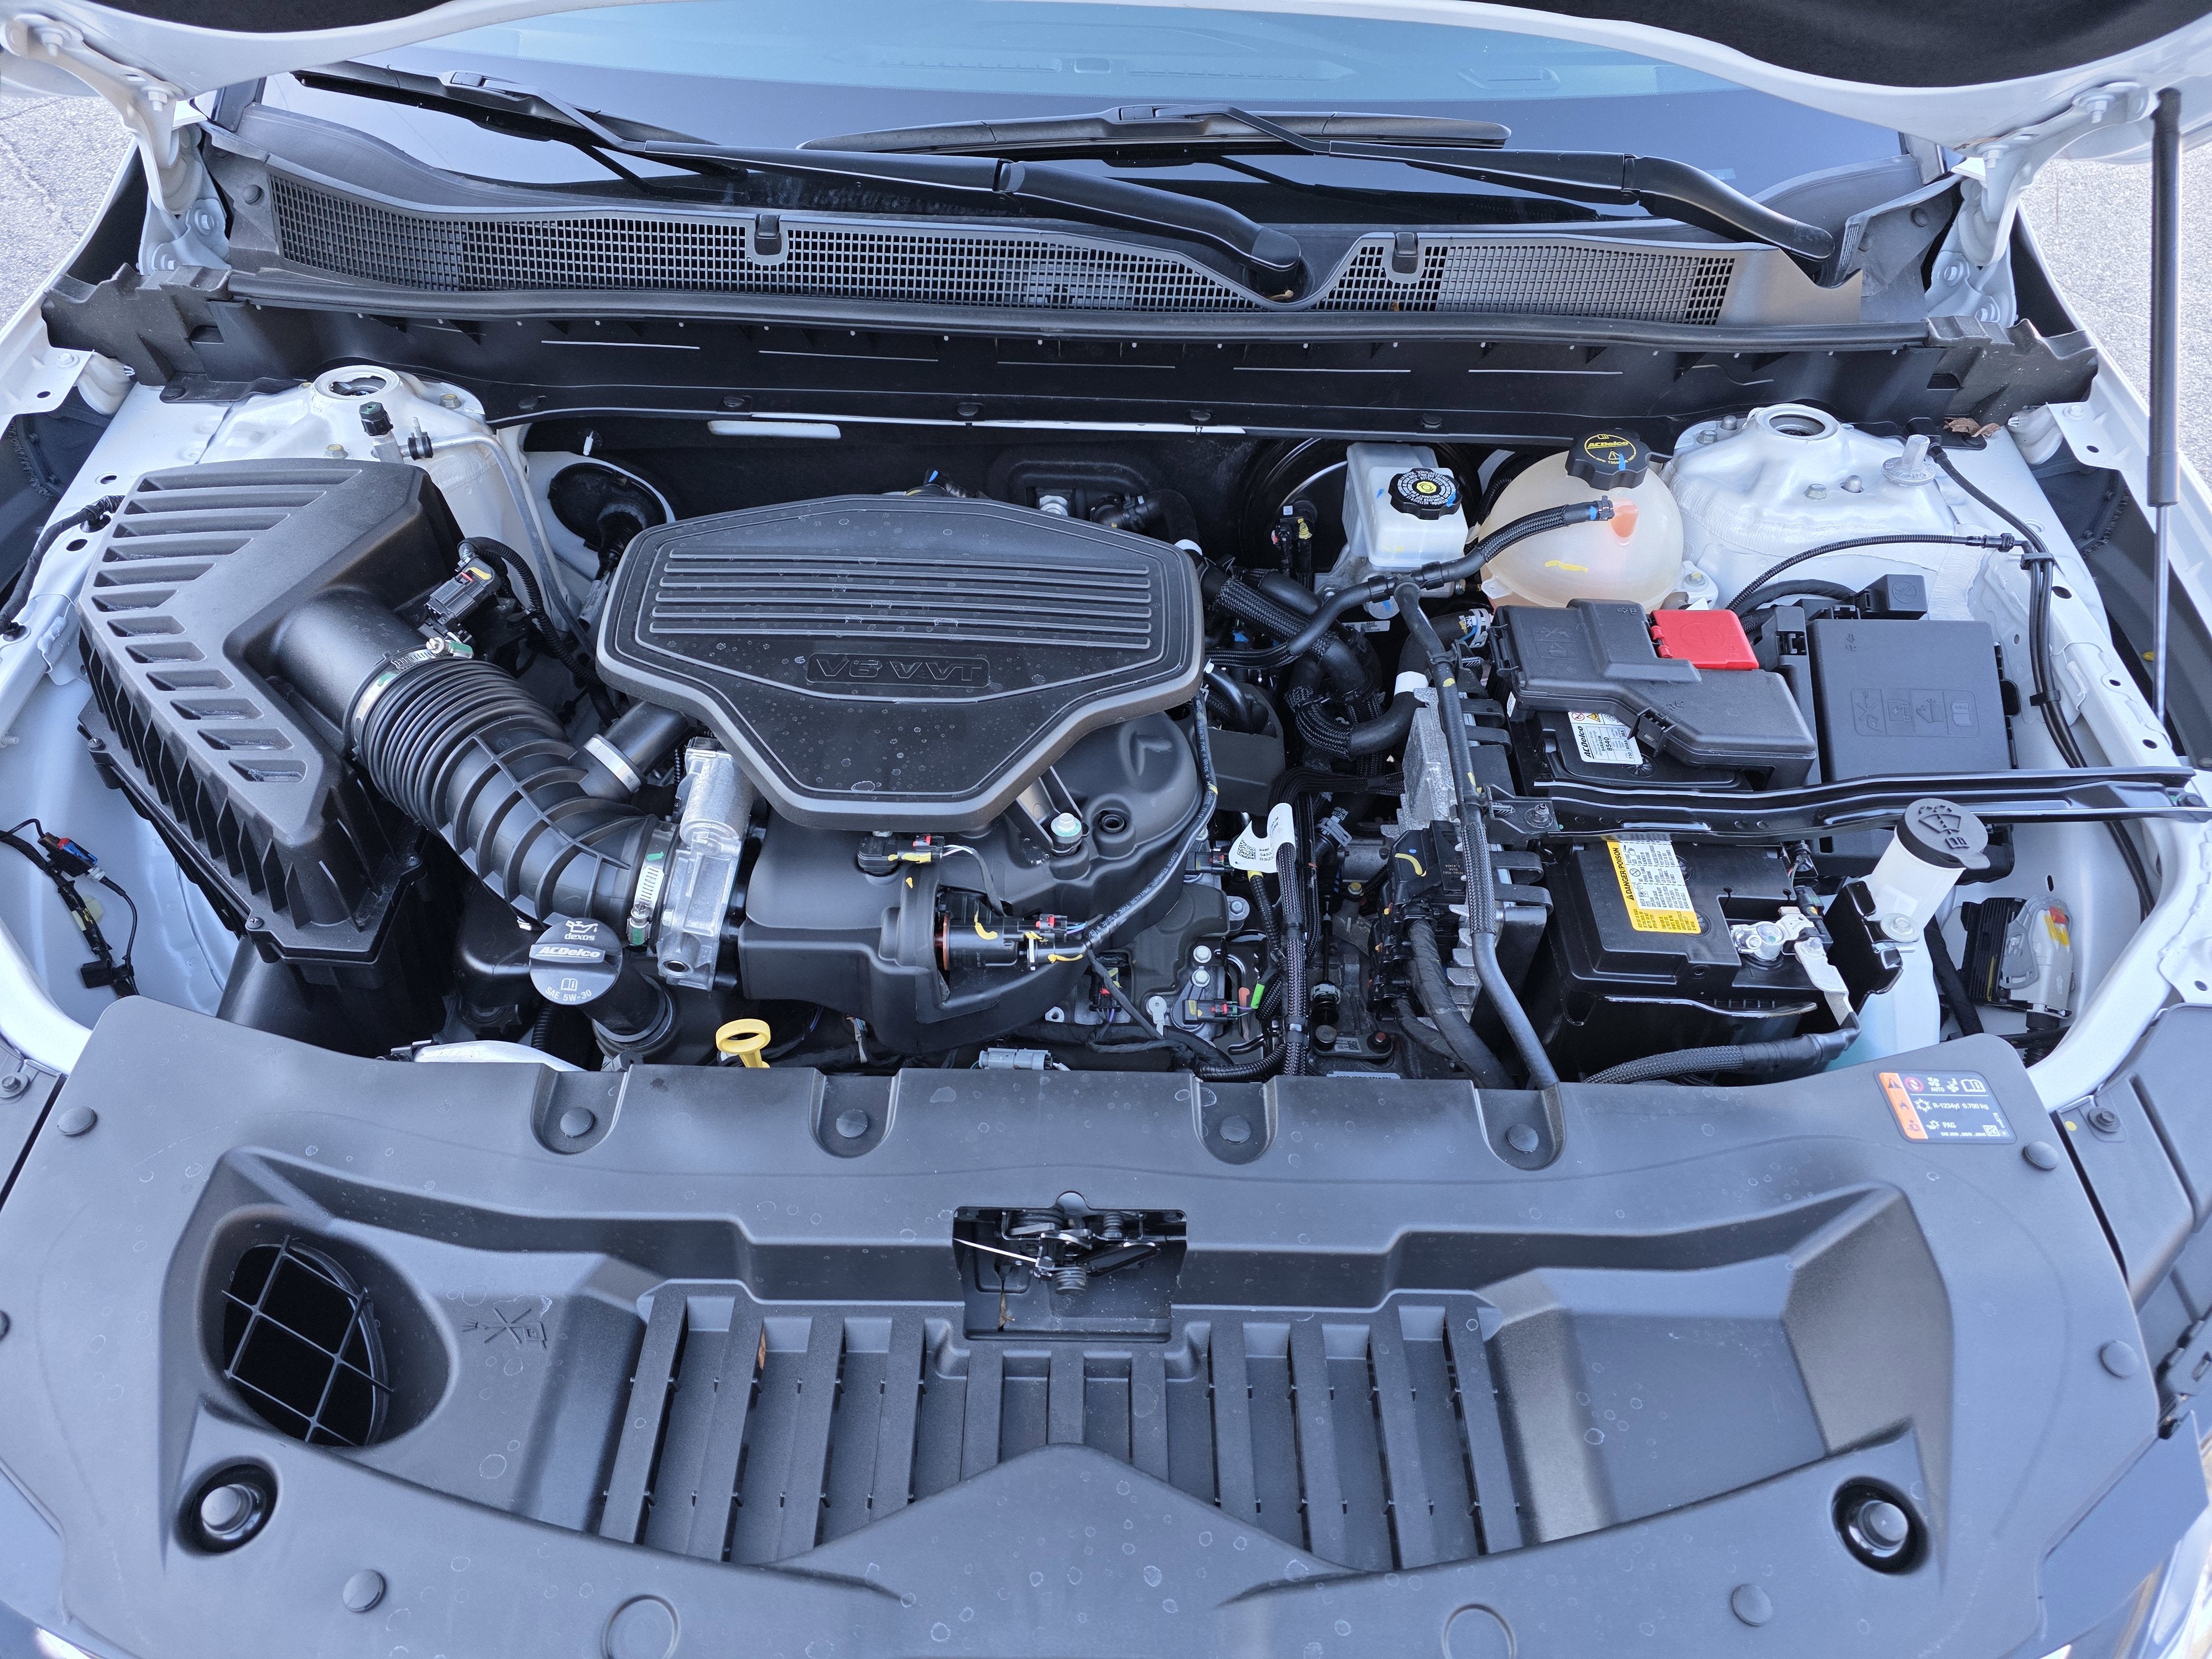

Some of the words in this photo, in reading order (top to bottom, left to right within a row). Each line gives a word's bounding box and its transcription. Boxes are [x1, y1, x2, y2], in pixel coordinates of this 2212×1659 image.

[1588, 441, 1629, 449] ACDelco
[816, 658, 879, 678] V6
[889, 660, 983, 682] VVT
[1578, 726, 1592, 758] ACDelco
[1603, 737, 1613, 751] 8540
[1612, 847, 1632, 894] DANGER/POISON
[565, 932, 596, 941] dexos
[538, 946, 601, 958] ACDelco
[545, 986, 561, 1000] SAE
[562, 989, 592, 1001] 5W-30
